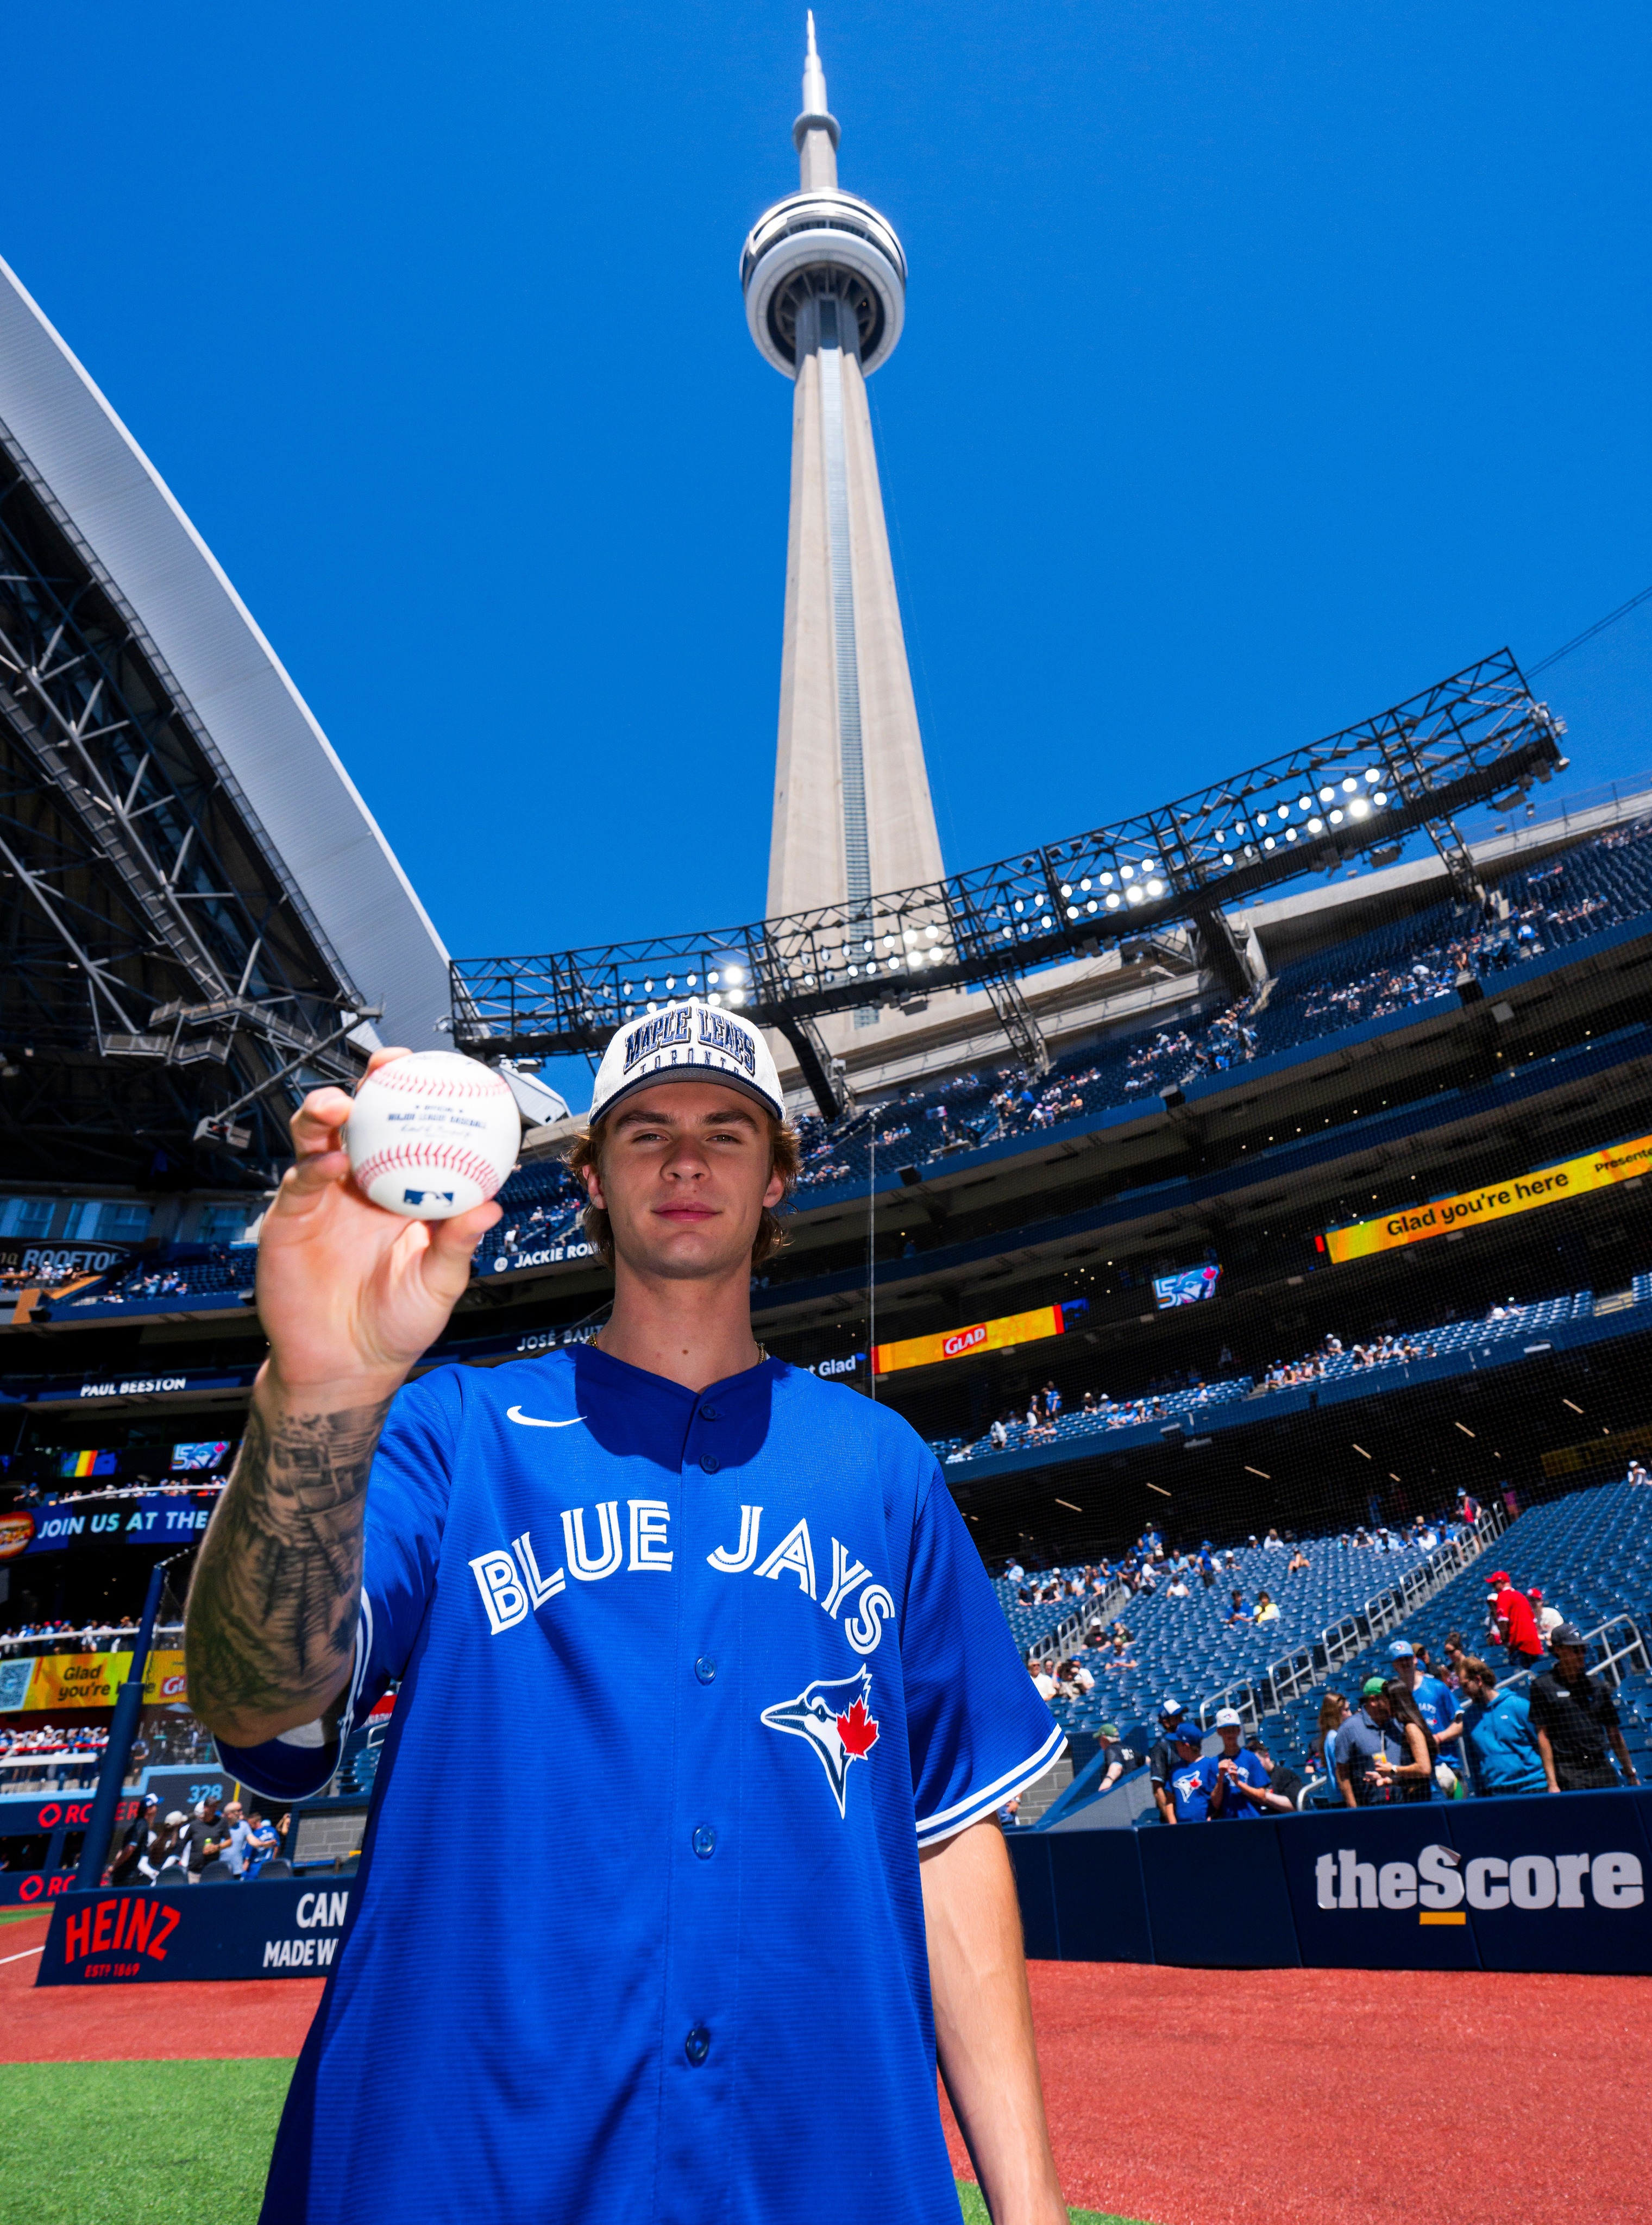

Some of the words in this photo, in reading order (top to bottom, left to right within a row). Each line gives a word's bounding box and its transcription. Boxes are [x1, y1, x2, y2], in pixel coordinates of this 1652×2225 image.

[624, 1005, 692, 1074] MAPLE
[696, 1008, 756, 1077] LEAFS
[1387, 1209, 1436, 1236] Glad
[1441, 1192, 1511, 1223] you're
[1515, 1172, 1568, 1199] here
[514, 1247, 564, 1268] JACKIE
[517, 1330, 556, 1352] JOSÉ
[945, 1328, 985, 1355] GLAD
[819, 1355, 856, 1376] Glad
[80, 1383, 116, 1397] PAUL
[120, 1377, 186, 1394] BEESTON
[37, 1516, 86, 1539] JOIN
[90, 1513, 121, 1533] US
[125, 1511, 159, 1531] AT
[166, 1510, 209, 1529] THE
[468, 1499, 674, 1636] BLUE
[706, 1505, 895, 1655] JAYS
[63, 1664, 102, 1681] Glad
[58, 1682, 111, 1701] you're
[187, 1783, 223, 1803] 328
[1315, 1844, 1644, 1910] theScore
[296, 1891, 349, 1928] CAN
[65, 1897, 181, 1964] HEINZ
[262, 1938, 316, 1968] MADE
[113, 1963, 141, 1977] 1869
